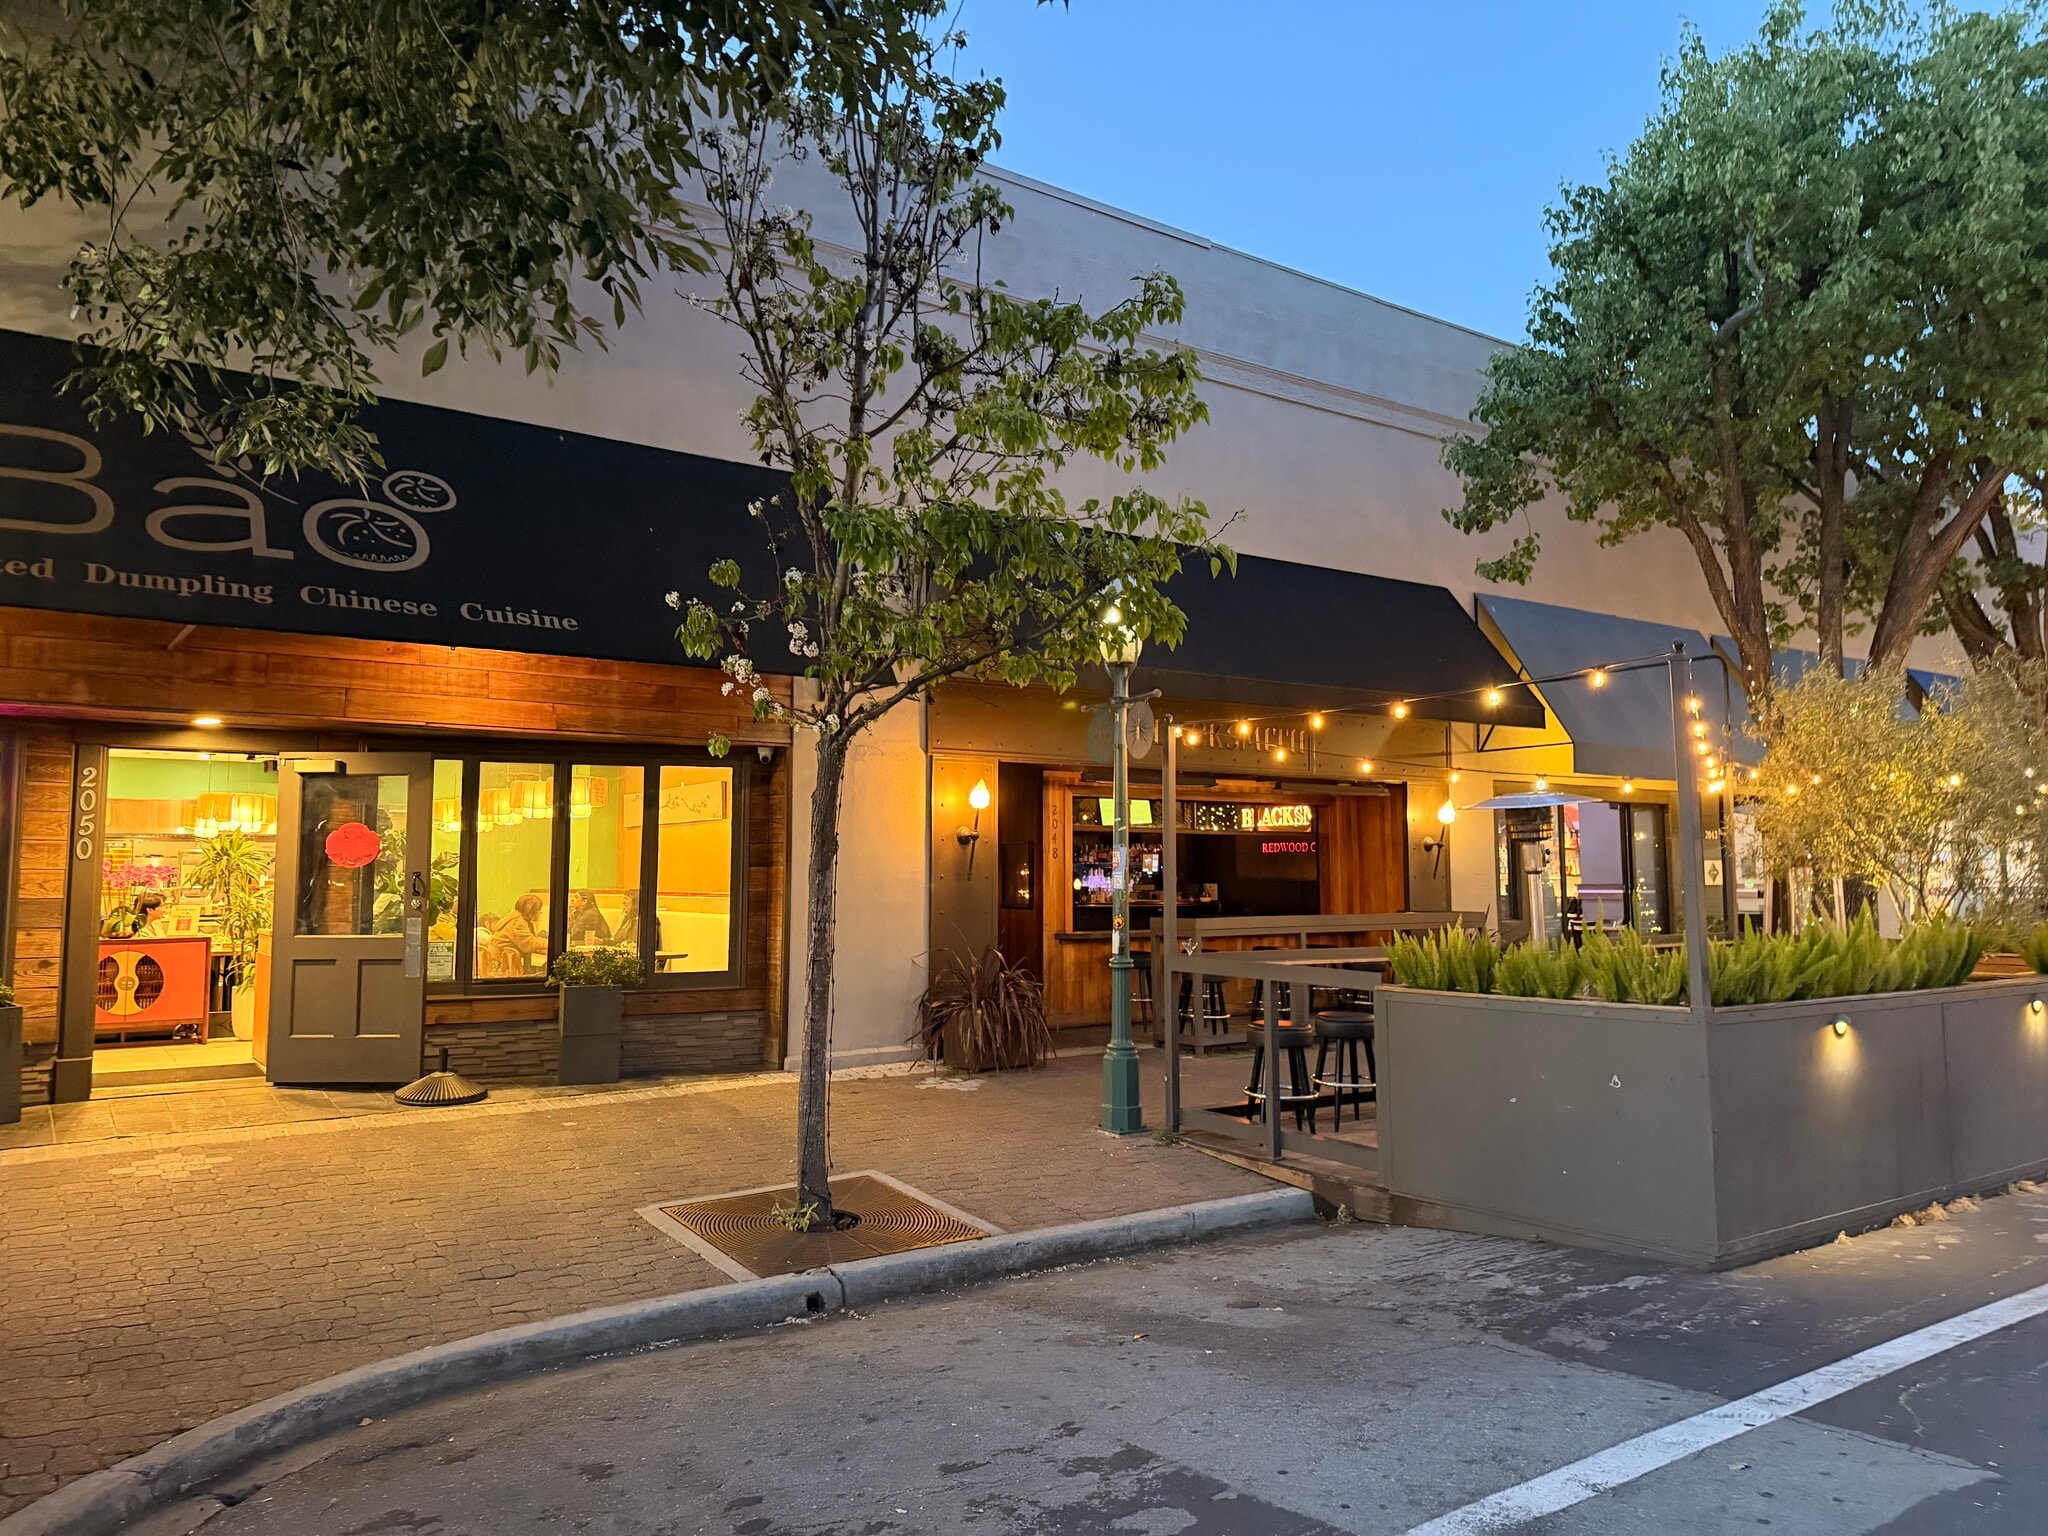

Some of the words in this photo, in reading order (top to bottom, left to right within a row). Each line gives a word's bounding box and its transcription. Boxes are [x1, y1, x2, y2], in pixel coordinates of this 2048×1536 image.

[0, 557, 55, 580] ed
[84, 562, 274, 604] Dumpling
[299, 585, 438, 617] Chinese
[459, 602, 580, 631] Cuisine
[76, 767, 97, 860] 2050
[1262, 842, 1309, 853] REDWOOD
